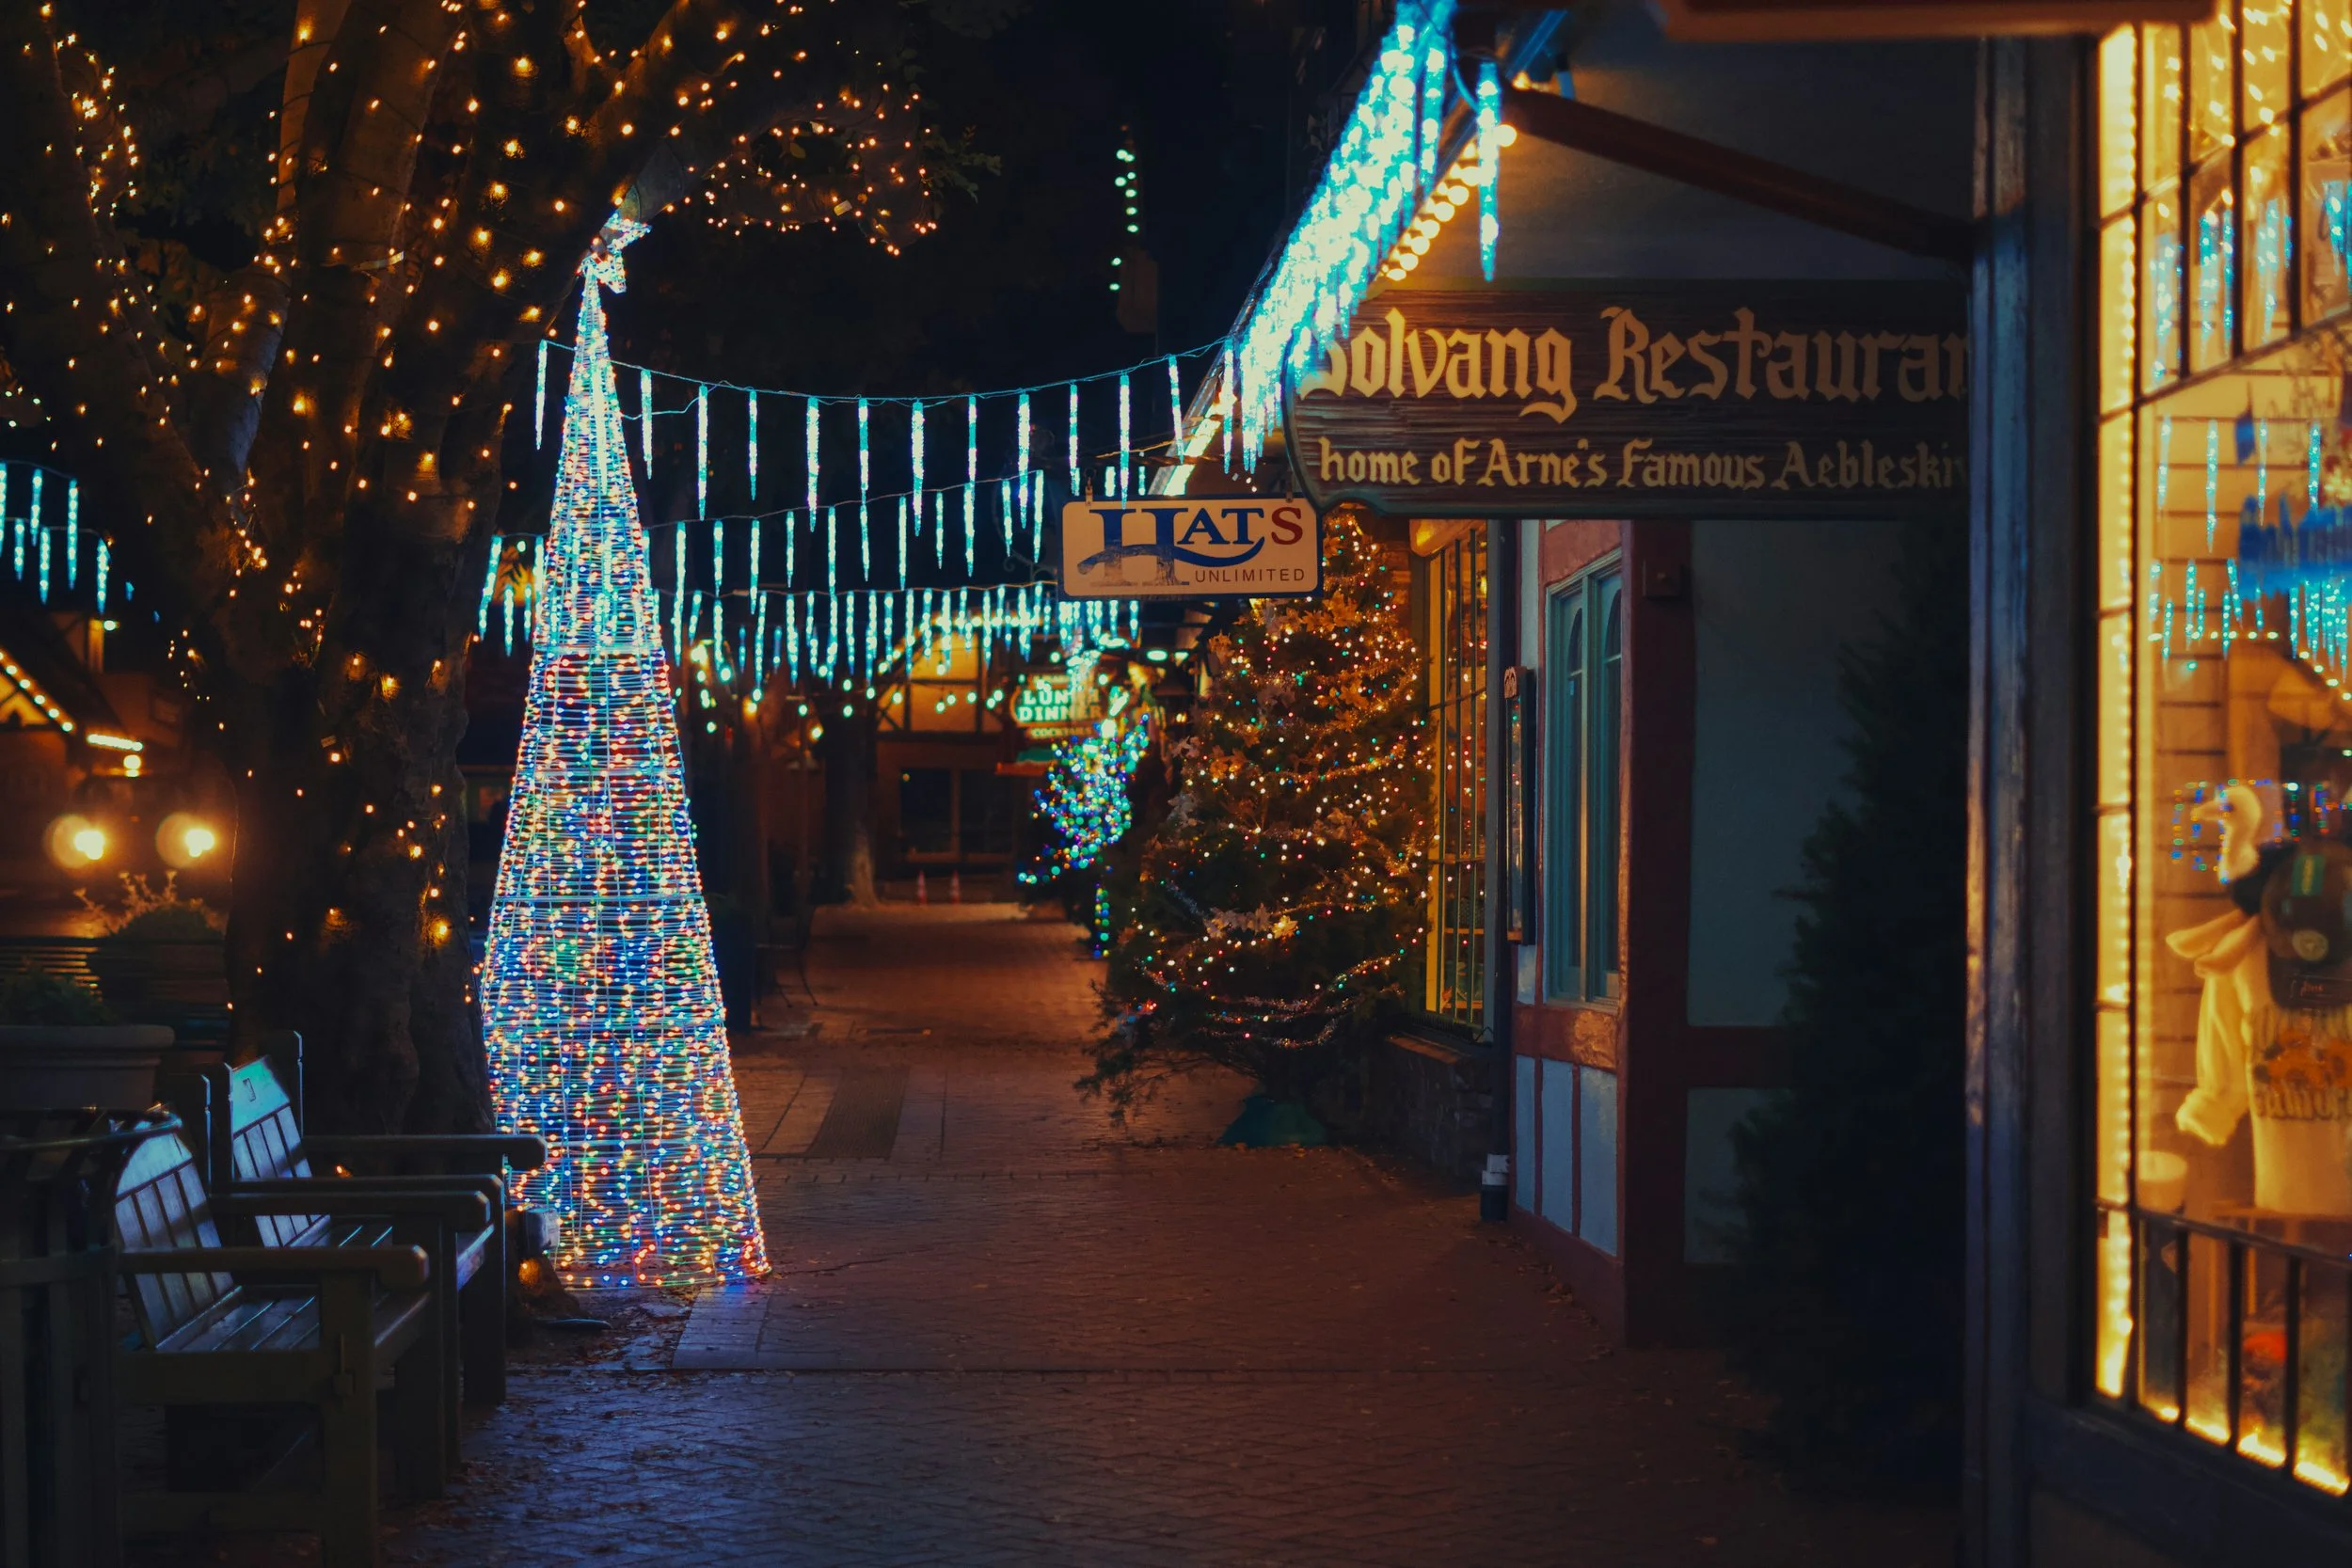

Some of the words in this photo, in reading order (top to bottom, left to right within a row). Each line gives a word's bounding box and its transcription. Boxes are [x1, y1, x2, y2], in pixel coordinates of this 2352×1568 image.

[1318, 436, 1422, 484] home
[1476, 437, 1608, 488] Arne's
[1078, 506, 1304, 587] HATS
[1195, 568, 1305, 583] UNLIMITED
[1023, 689, 1099, 705] LUNH
